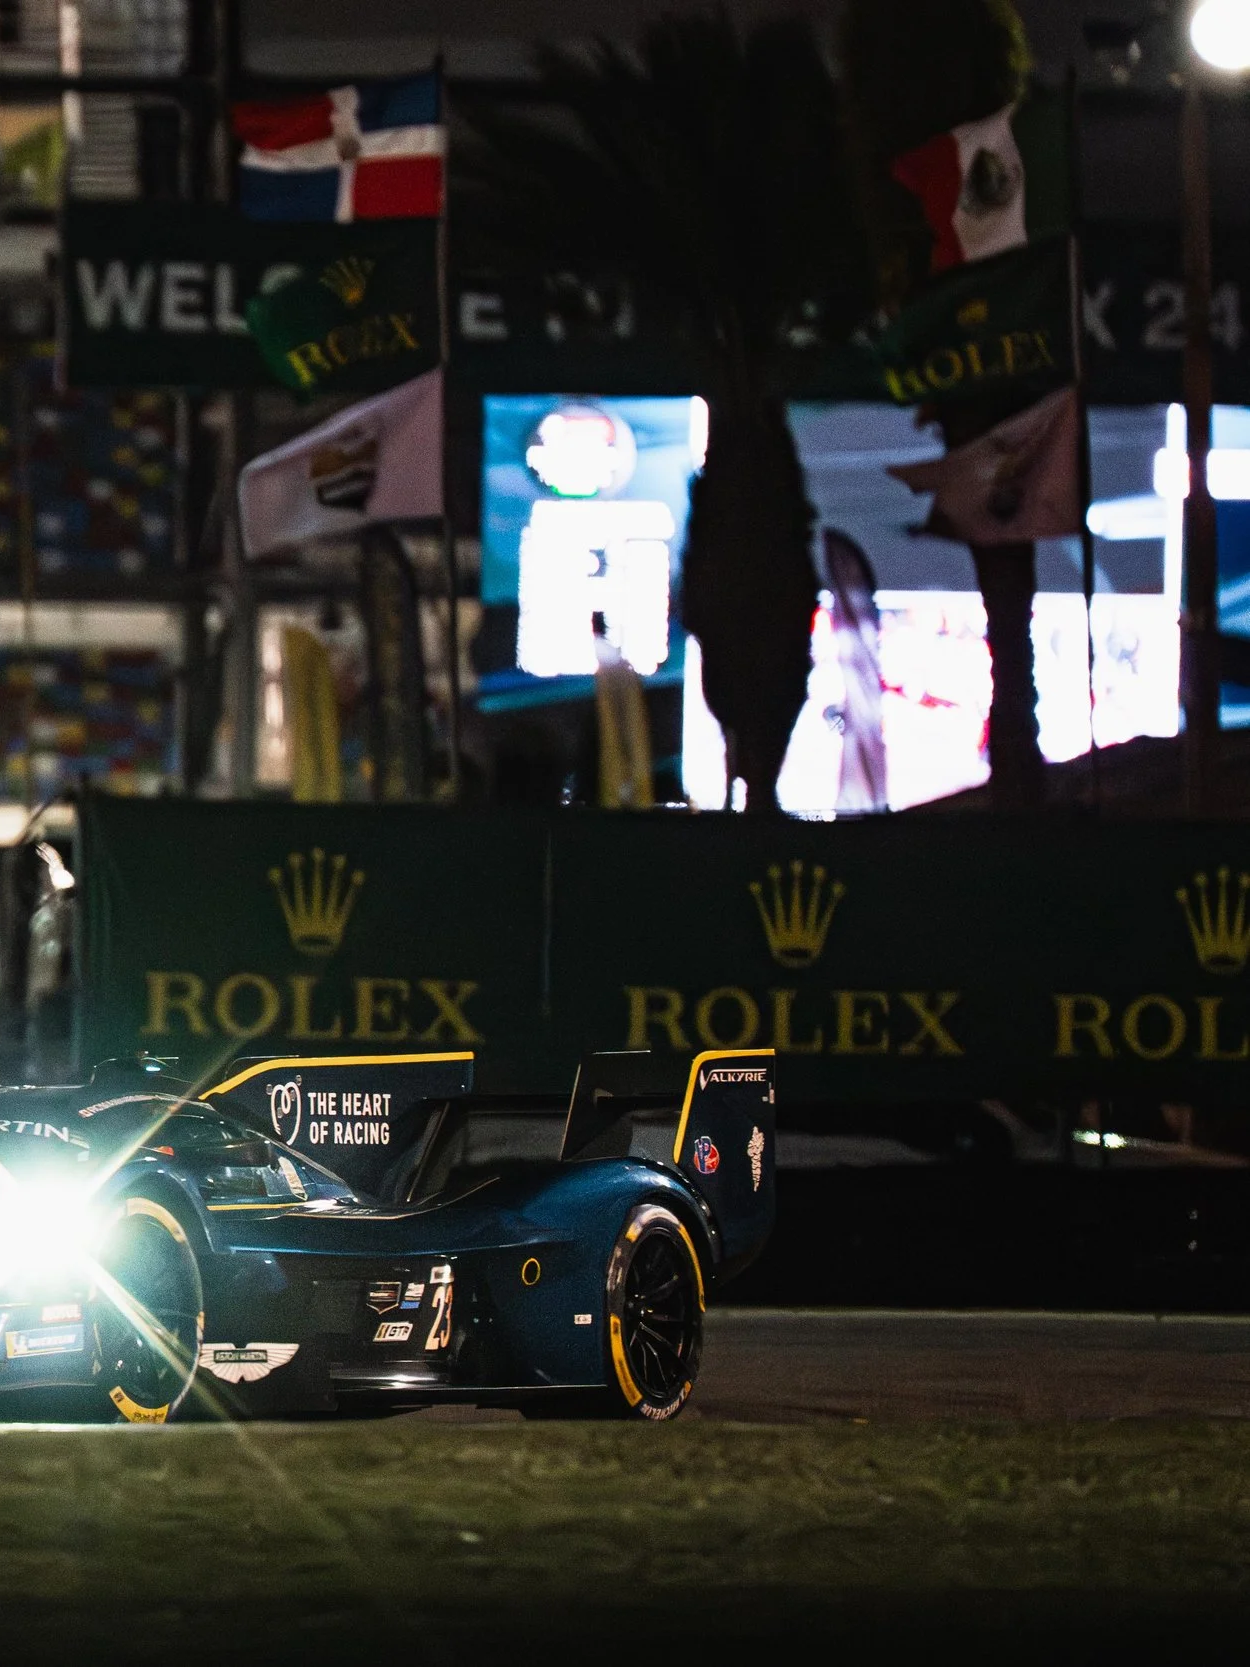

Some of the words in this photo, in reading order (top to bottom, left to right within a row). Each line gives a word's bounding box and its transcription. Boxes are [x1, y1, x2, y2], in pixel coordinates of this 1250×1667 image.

[140, 970, 485, 1046] ROLEX
[623, 984, 965, 1057] ROLEX
[699, 1067, 767, 1092] VALKYRIE
[307, 1092, 337, 1116] THE
[342, 1093, 391, 1117] HEART
[309, 1121, 329, 1145] OF
[333, 1121, 390, 1146] RACING
[424, 1283, 453, 1350] 23
